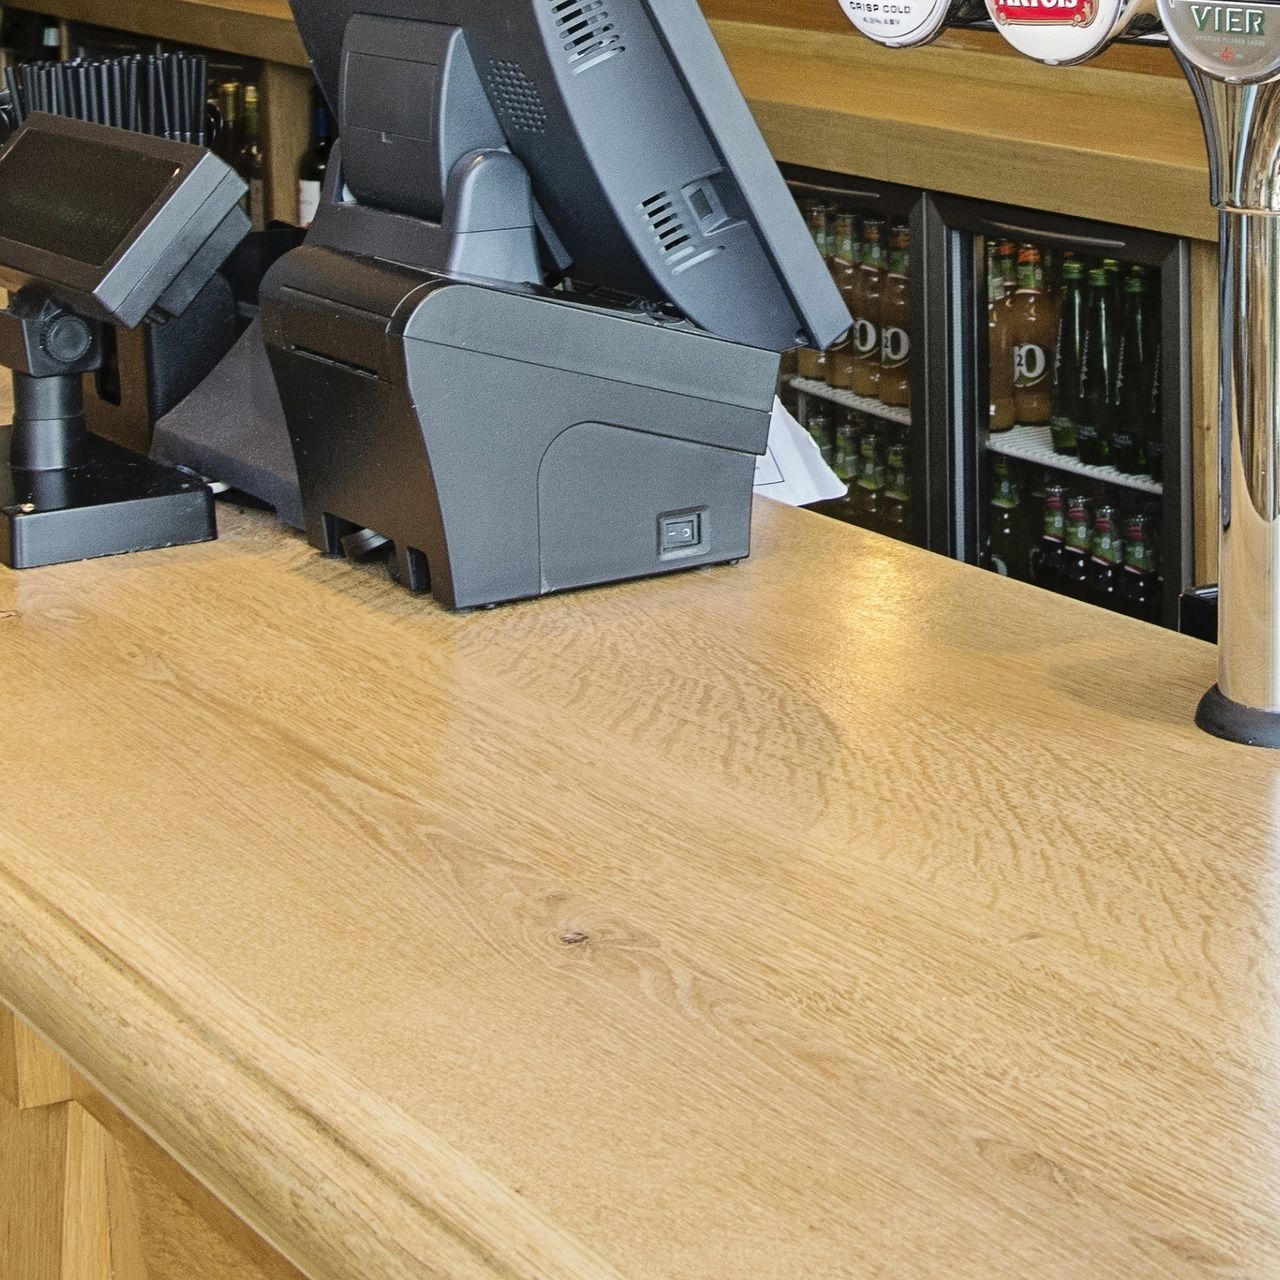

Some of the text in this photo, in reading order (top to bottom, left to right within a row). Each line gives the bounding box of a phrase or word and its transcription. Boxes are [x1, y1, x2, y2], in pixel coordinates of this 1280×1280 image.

[849, 1, 911, 14] CRISP COLD
[1191, 5, 1265, 35] VIER
